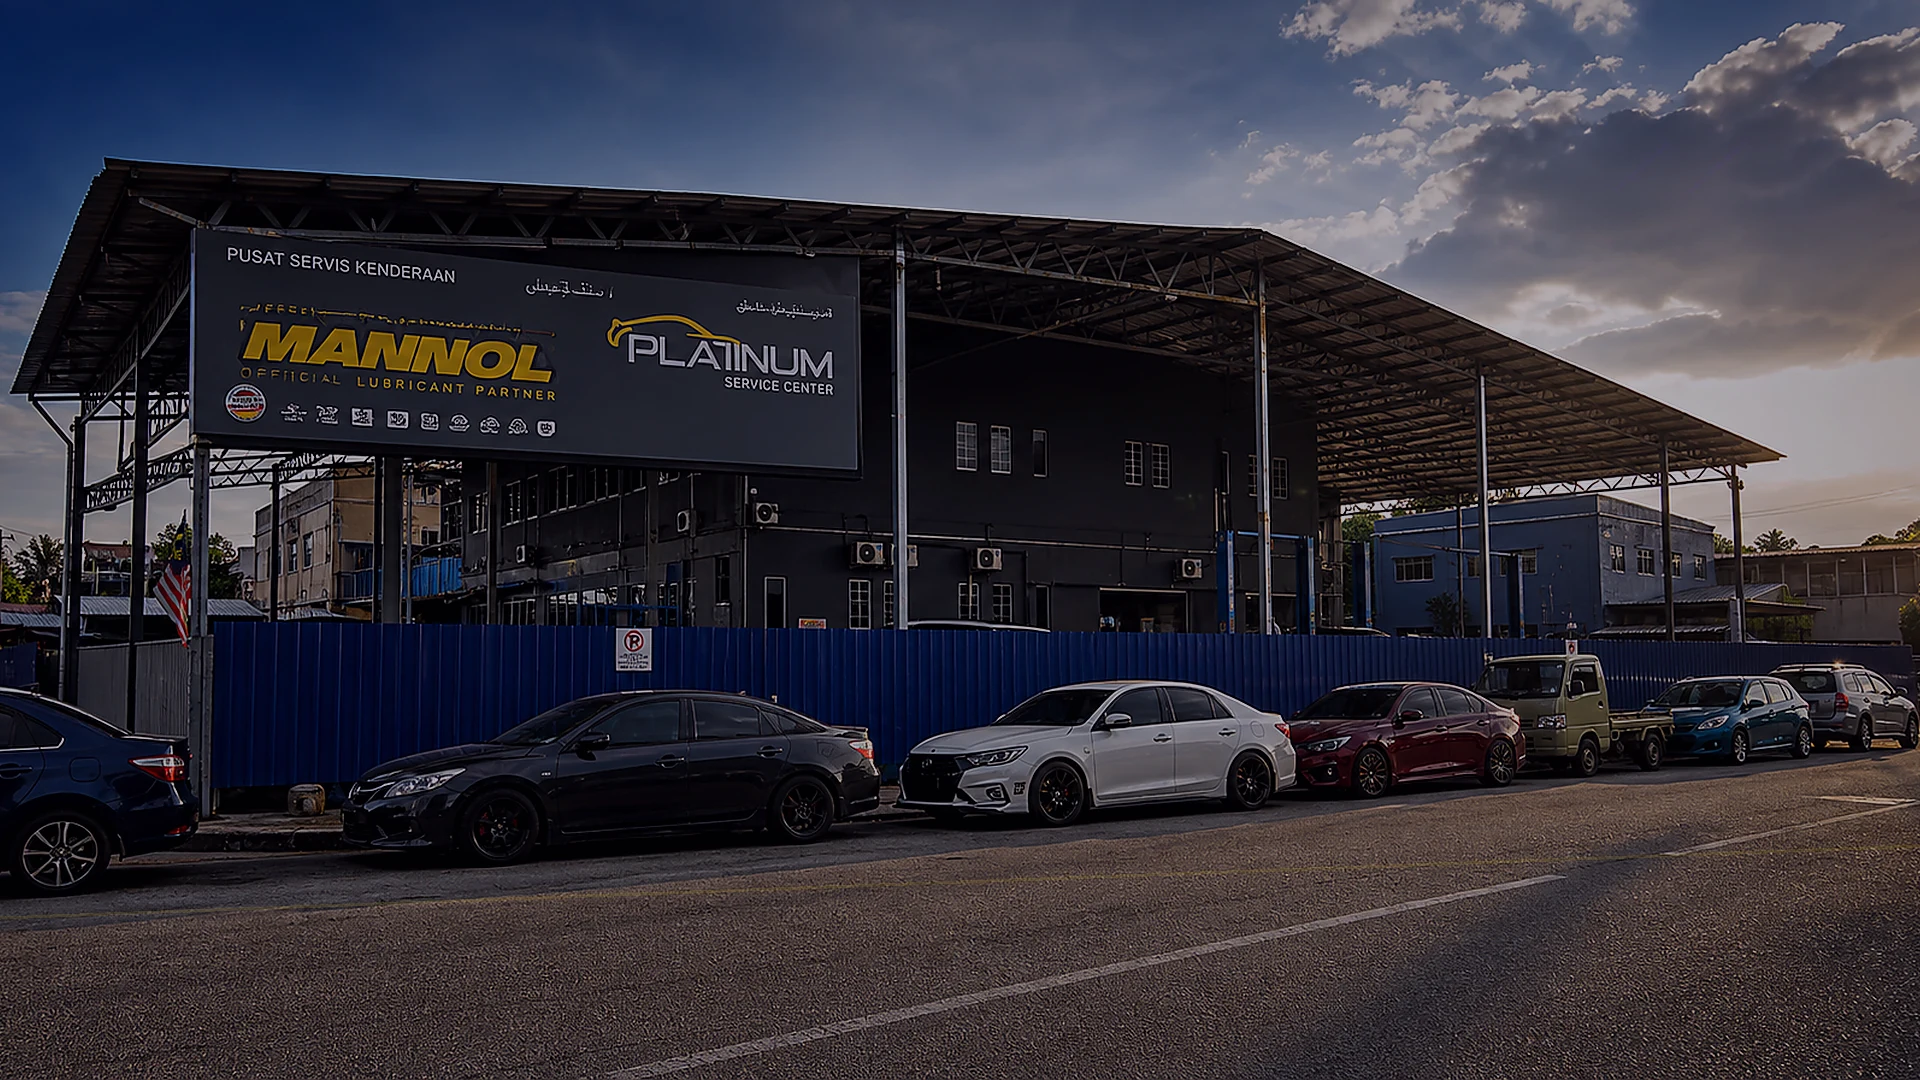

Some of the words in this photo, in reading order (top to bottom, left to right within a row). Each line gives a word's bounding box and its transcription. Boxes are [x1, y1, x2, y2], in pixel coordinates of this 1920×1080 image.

[226, 247, 285, 266] PUSAT
[288, 252, 351, 273] SERVIS
[354, 260, 457, 284] KENDERAAN
[242, 321, 553, 383] MANNOL
[627, 333, 834, 379] PLATINUM
[356, 376, 465, 394] LUBRICANT
[474, 385, 557, 401] PARTNER
[723, 376, 780, 392] SERVICE
[782, 381, 834, 396] CENTER
